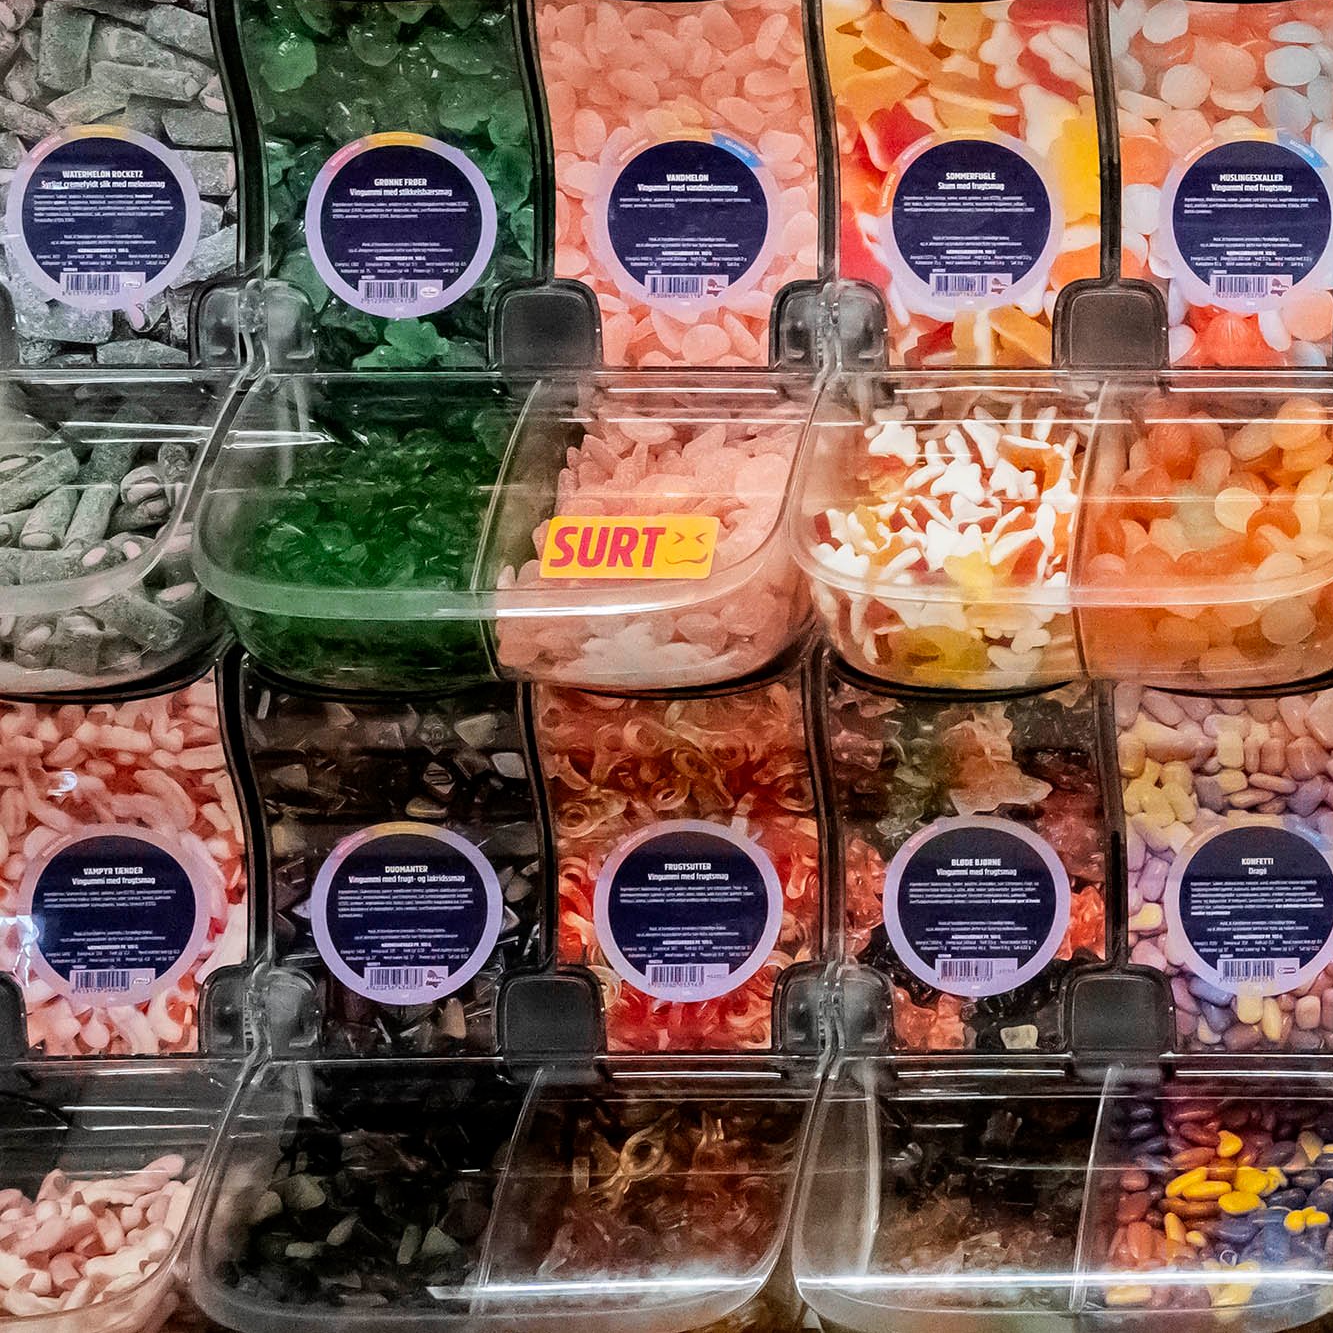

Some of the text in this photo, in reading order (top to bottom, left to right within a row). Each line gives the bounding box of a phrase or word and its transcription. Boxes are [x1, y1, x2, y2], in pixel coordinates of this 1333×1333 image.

[62, 170, 143, 179] WATERMELON ROCKETZ
[666, 174, 708, 182] VANDMELON
[946, 172, 995, 181] SOMMERFUGLE
[1220, 174, 1283, 182] MUSLINGESKALLER
[374, 178, 427, 187] GRØNNE FRØER
[350, 188, 382, 197] Vingummi
[384, 188, 398, 196] med
[1212, 183, 1292, 193] Vingummi med frugtsmag
[550, 526, 667, 567] SURT
[952, 858, 1001, 867] BLØDE BJØRNE
[1242, 857, 1273, 866] KONFETTI
[84, 867, 143, 875] VAMPYR TÆNDER
[385, 866, 428, 874] DUOMANTER
[665, 862, 711, 871] FRUGTSUTTER
[349, 875, 465, 884] Vingummi med frugt- og lakridssmag
